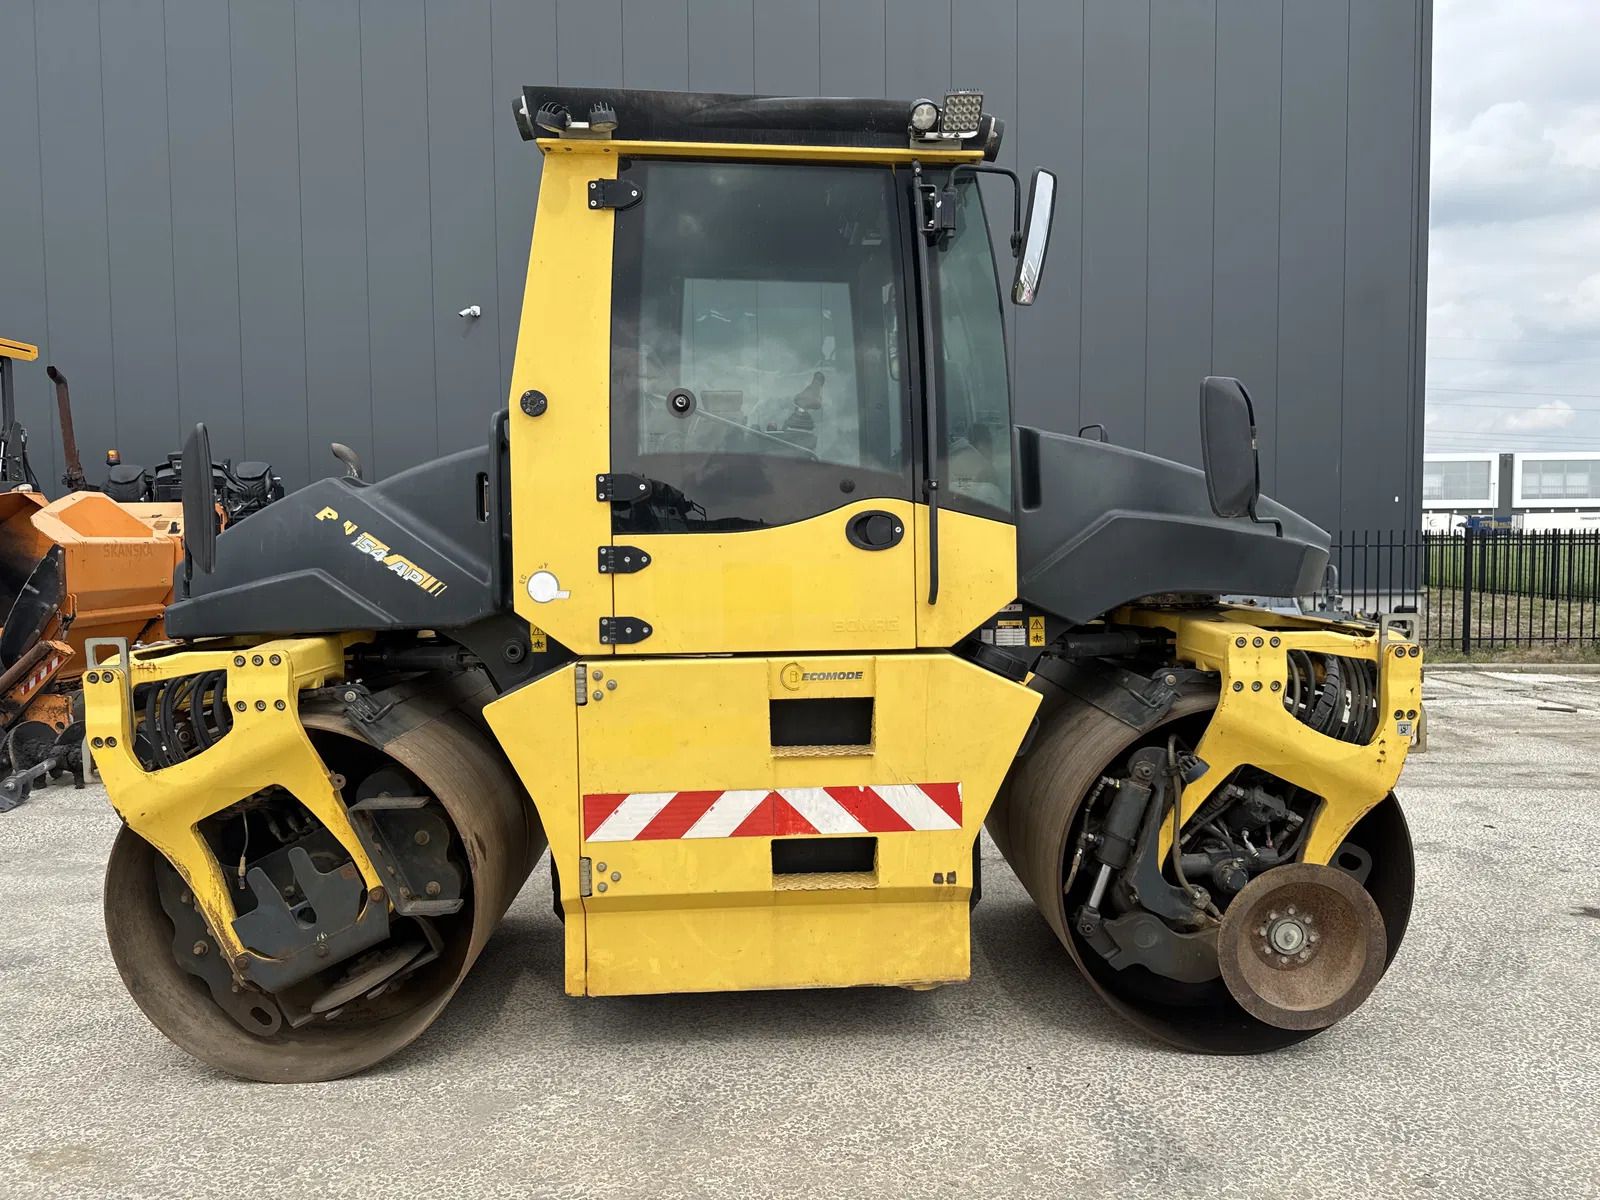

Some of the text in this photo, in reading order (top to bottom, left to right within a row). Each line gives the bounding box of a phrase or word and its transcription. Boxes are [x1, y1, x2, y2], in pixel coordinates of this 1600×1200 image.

[103, 544, 153, 558] SKANSKA
[387, 561, 424, 584] AP
[801, 671, 863, 681] ECOMODE
